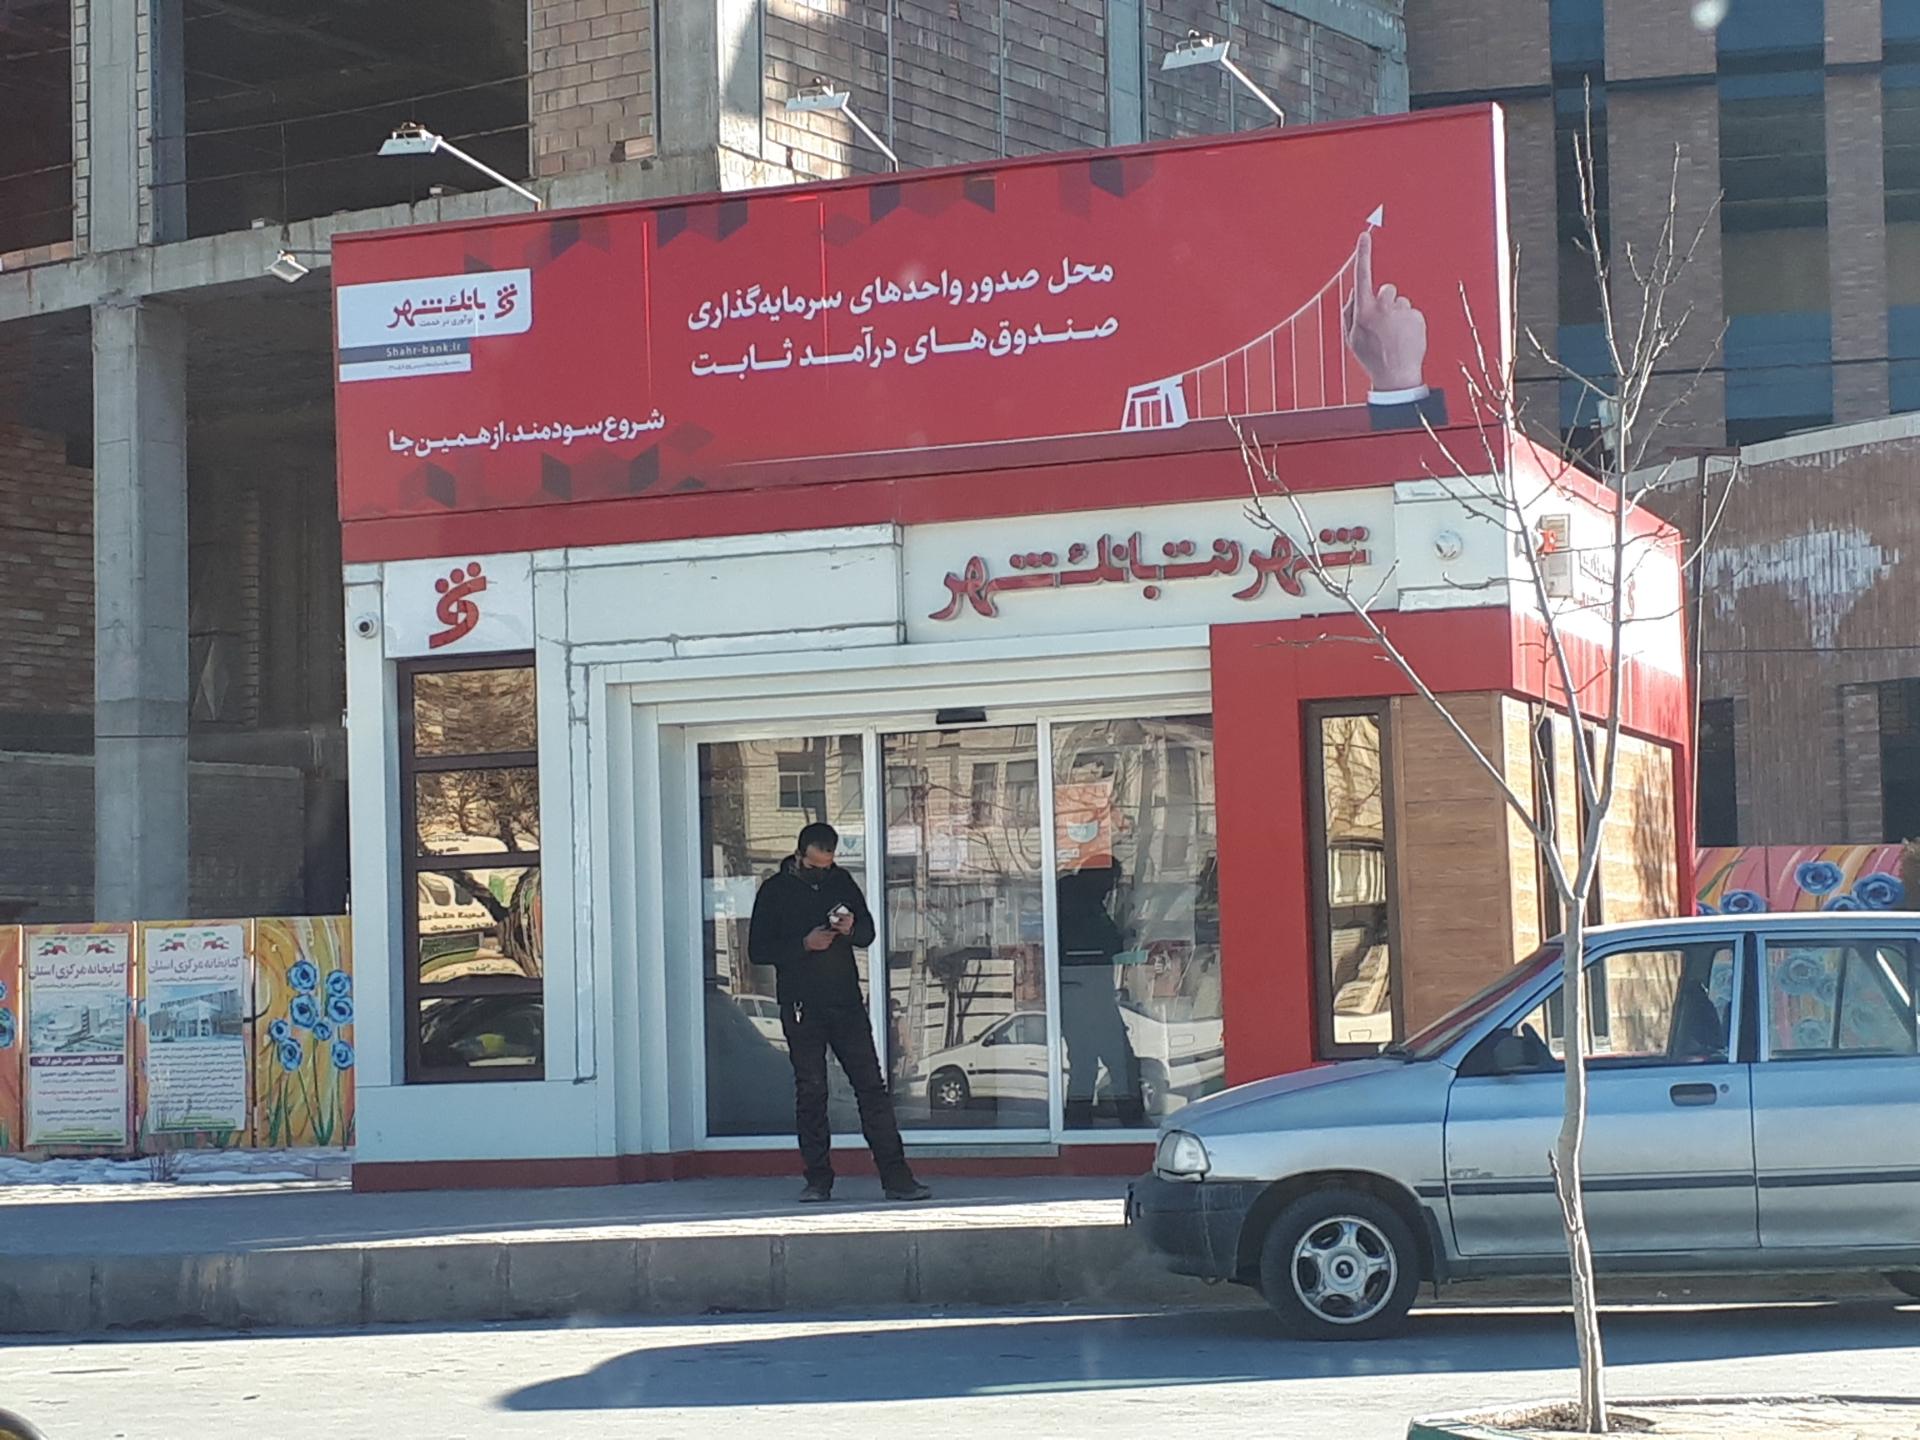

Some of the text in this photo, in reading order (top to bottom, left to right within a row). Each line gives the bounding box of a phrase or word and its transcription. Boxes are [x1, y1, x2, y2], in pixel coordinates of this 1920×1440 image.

[849, 269, 963, 314] واحدهای
[966, 267, 1040, 303] صدور
[1047, 256, 1114, 294] محل
[386, 286, 487, 328] بانک شهر
[691, 337, 793, 380] ثابت
[799, 326, 897, 368] درآمد
[603, 408, 666, 442] شروع
[928, 550, 1059, 621] شهر
[1059, 531, 1162, 600] بانک
[56, 963, 87, 979] مرکزی
[88, 962, 126, 977] کتابخانه
